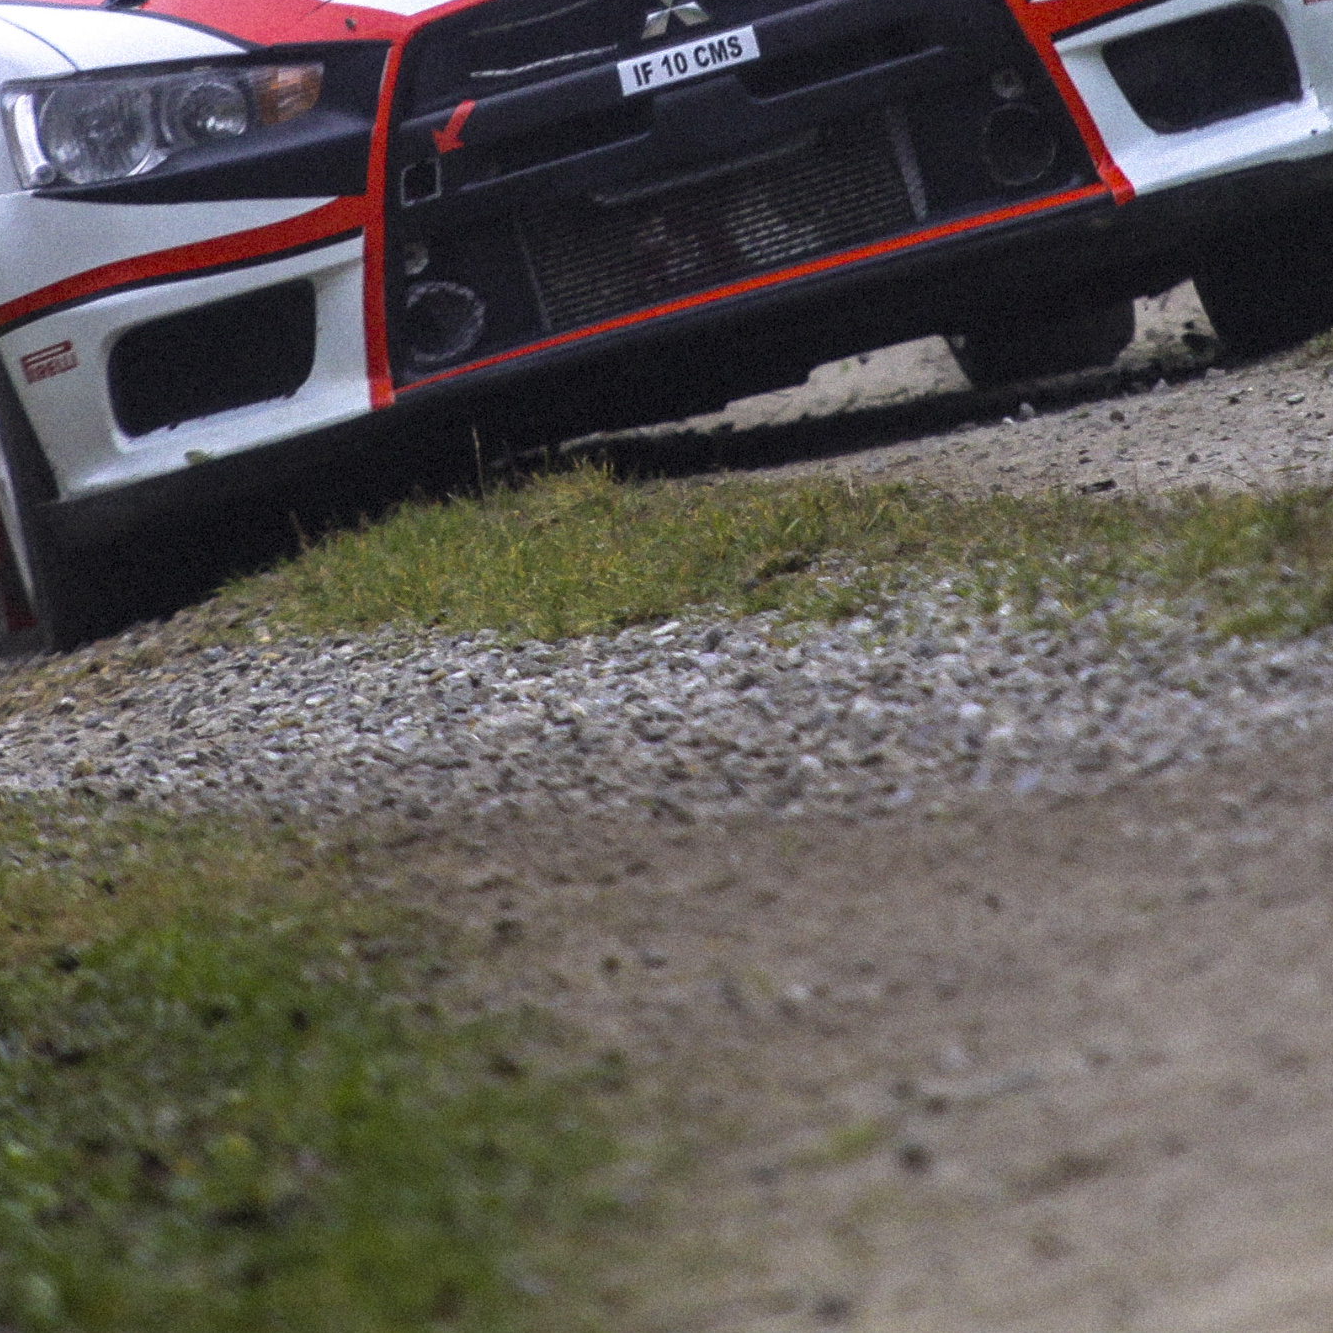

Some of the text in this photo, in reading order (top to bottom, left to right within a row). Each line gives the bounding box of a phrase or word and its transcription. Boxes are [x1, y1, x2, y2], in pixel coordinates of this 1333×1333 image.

[633, 35, 743, 86] IF 10 CMS
